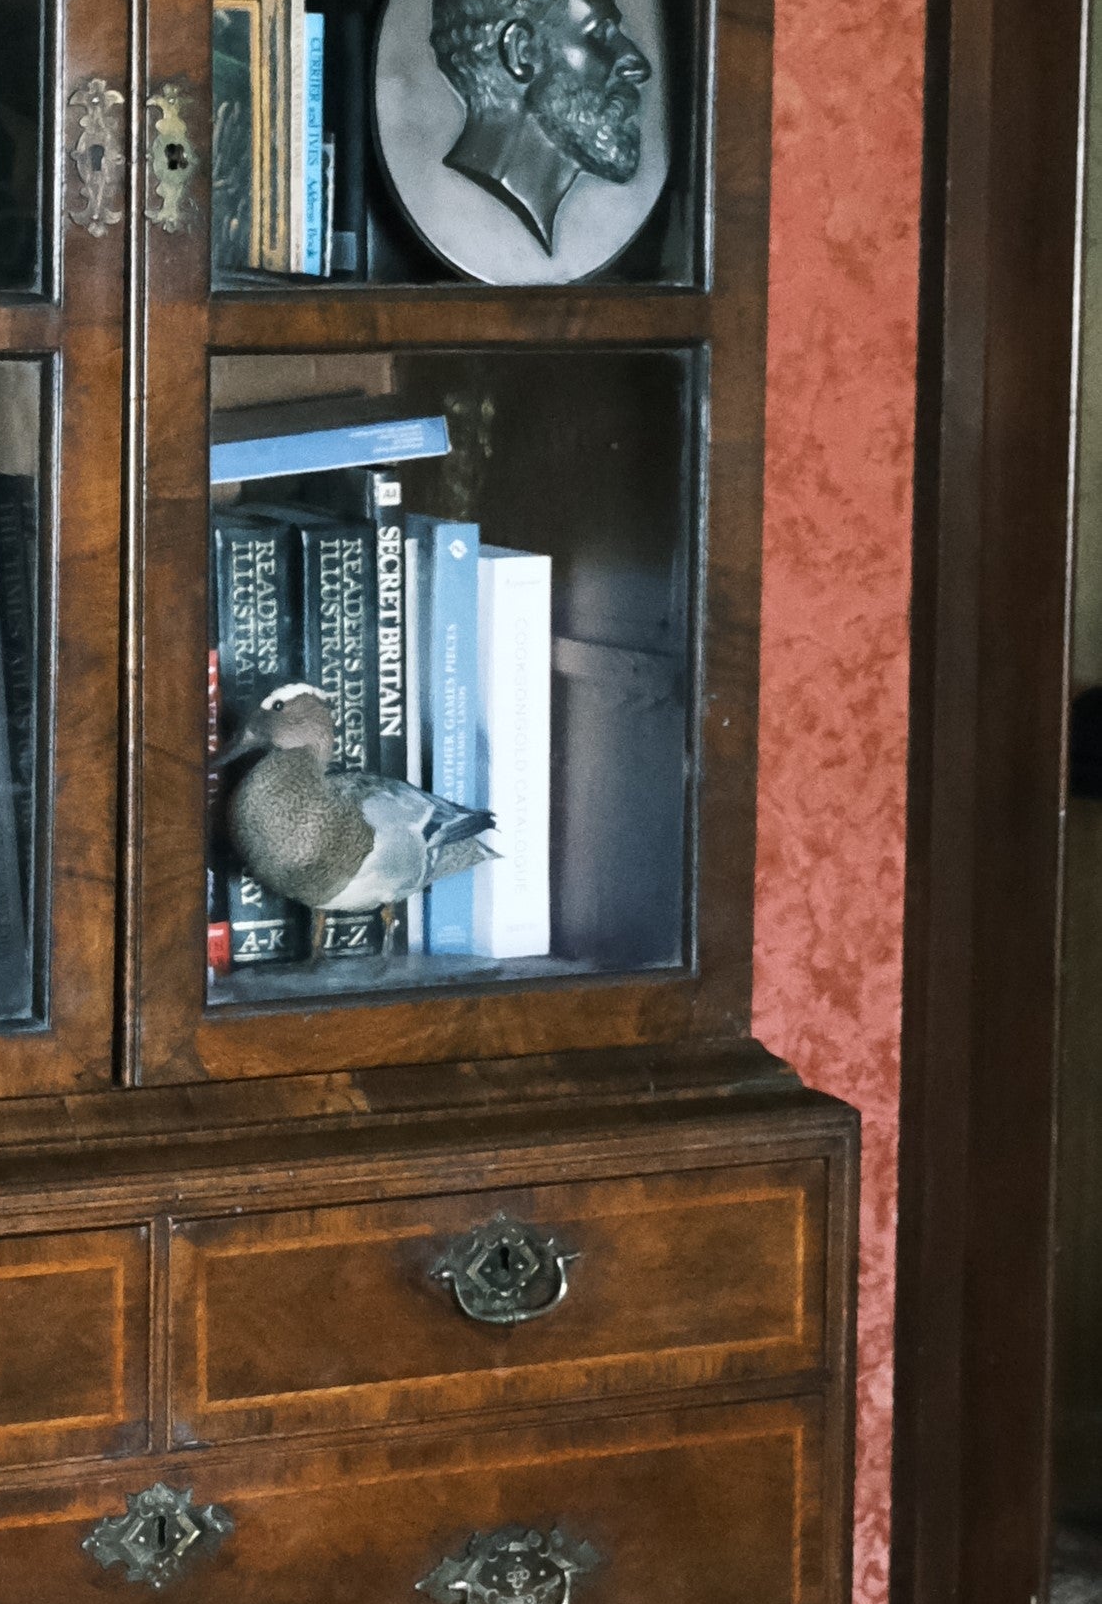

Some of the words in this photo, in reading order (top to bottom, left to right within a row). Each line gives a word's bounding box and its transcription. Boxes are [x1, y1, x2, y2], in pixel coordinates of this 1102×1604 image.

[307, 36, 321, 102] CURRIER
[307, 106, 321, 129] and
[307, 132, 320, 166] IVES
[306, 176, 318, 224] Address
[378, 525, 402, 624] SECRET
[255, 540, 279, 674] READER'S
[342, 538, 365, 672] READER'S
[444, 622, 457, 673] PIECES
[379, 626, 402, 737] BRITAIN
[443, 677, 456, 731] GAMES
[343, 679, 366, 770] DIGEST
[443, 735, 455, 787] OTHER
[513, 779, 530, 895] CATALOGUE
[237, 929, 285, 953] A-K
[324, 925, 369, 948] L-Z
